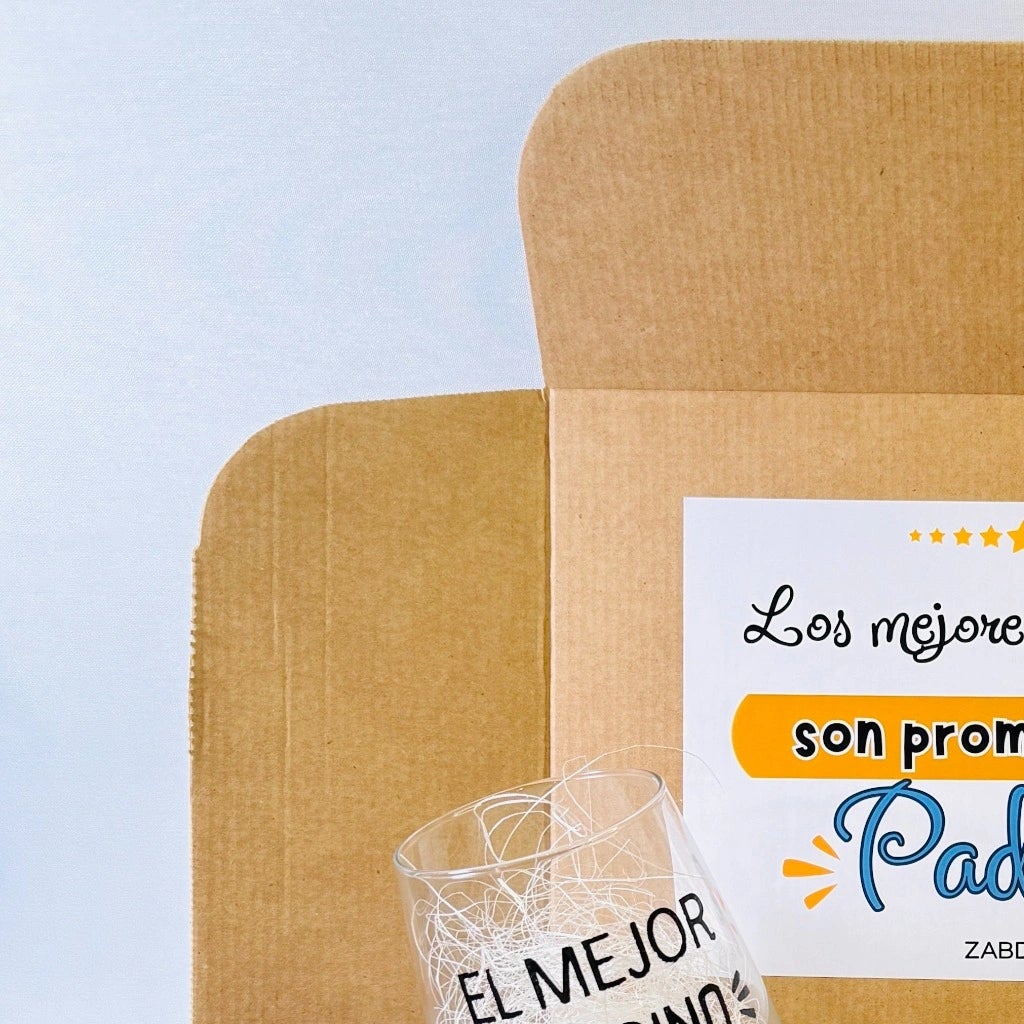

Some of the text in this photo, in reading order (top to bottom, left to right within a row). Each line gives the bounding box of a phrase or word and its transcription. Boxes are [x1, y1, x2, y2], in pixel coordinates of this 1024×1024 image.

[744, 584, 852, 646] Los
[793, 717, 884, 760] son
[458, 892, 716, 1024] EL MEJOR
